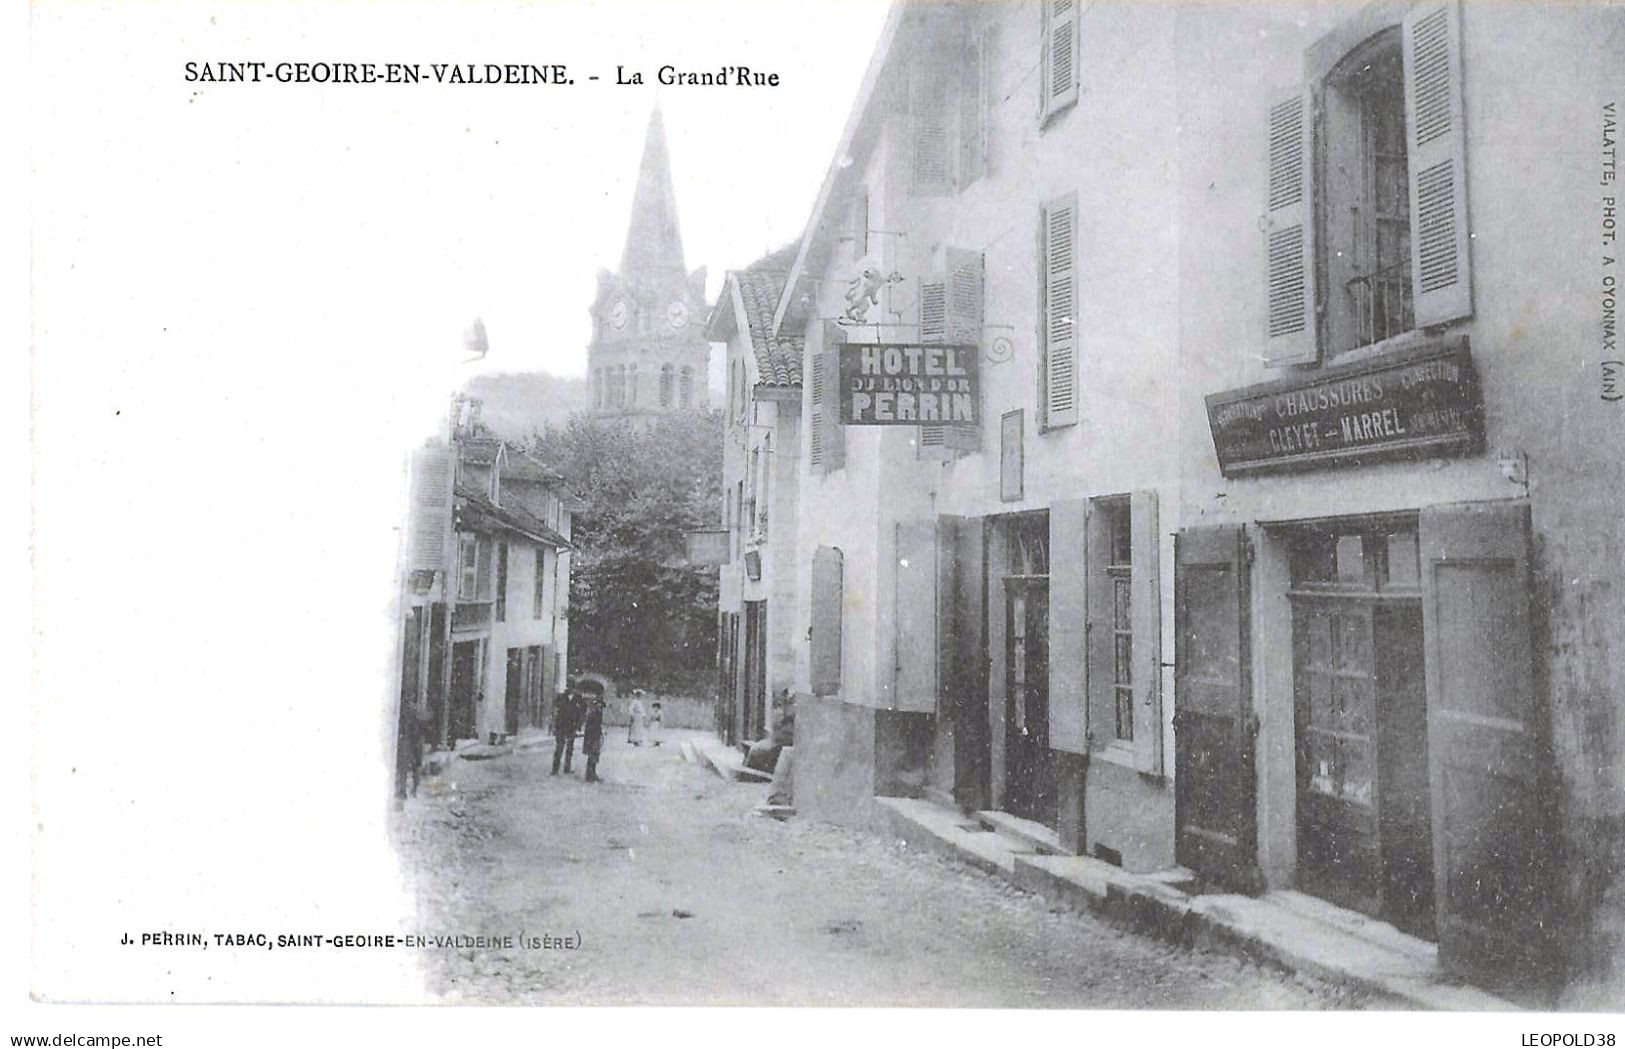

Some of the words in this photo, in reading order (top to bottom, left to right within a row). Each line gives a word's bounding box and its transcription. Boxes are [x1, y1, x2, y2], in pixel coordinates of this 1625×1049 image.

[861, 347, 966, 376] HOTEL
[852, 392, 973, 421] PERRIN
[1275, 377, 1384, 417] CHAUSSURES
[1341, 408, 1406, 442] MARREL
